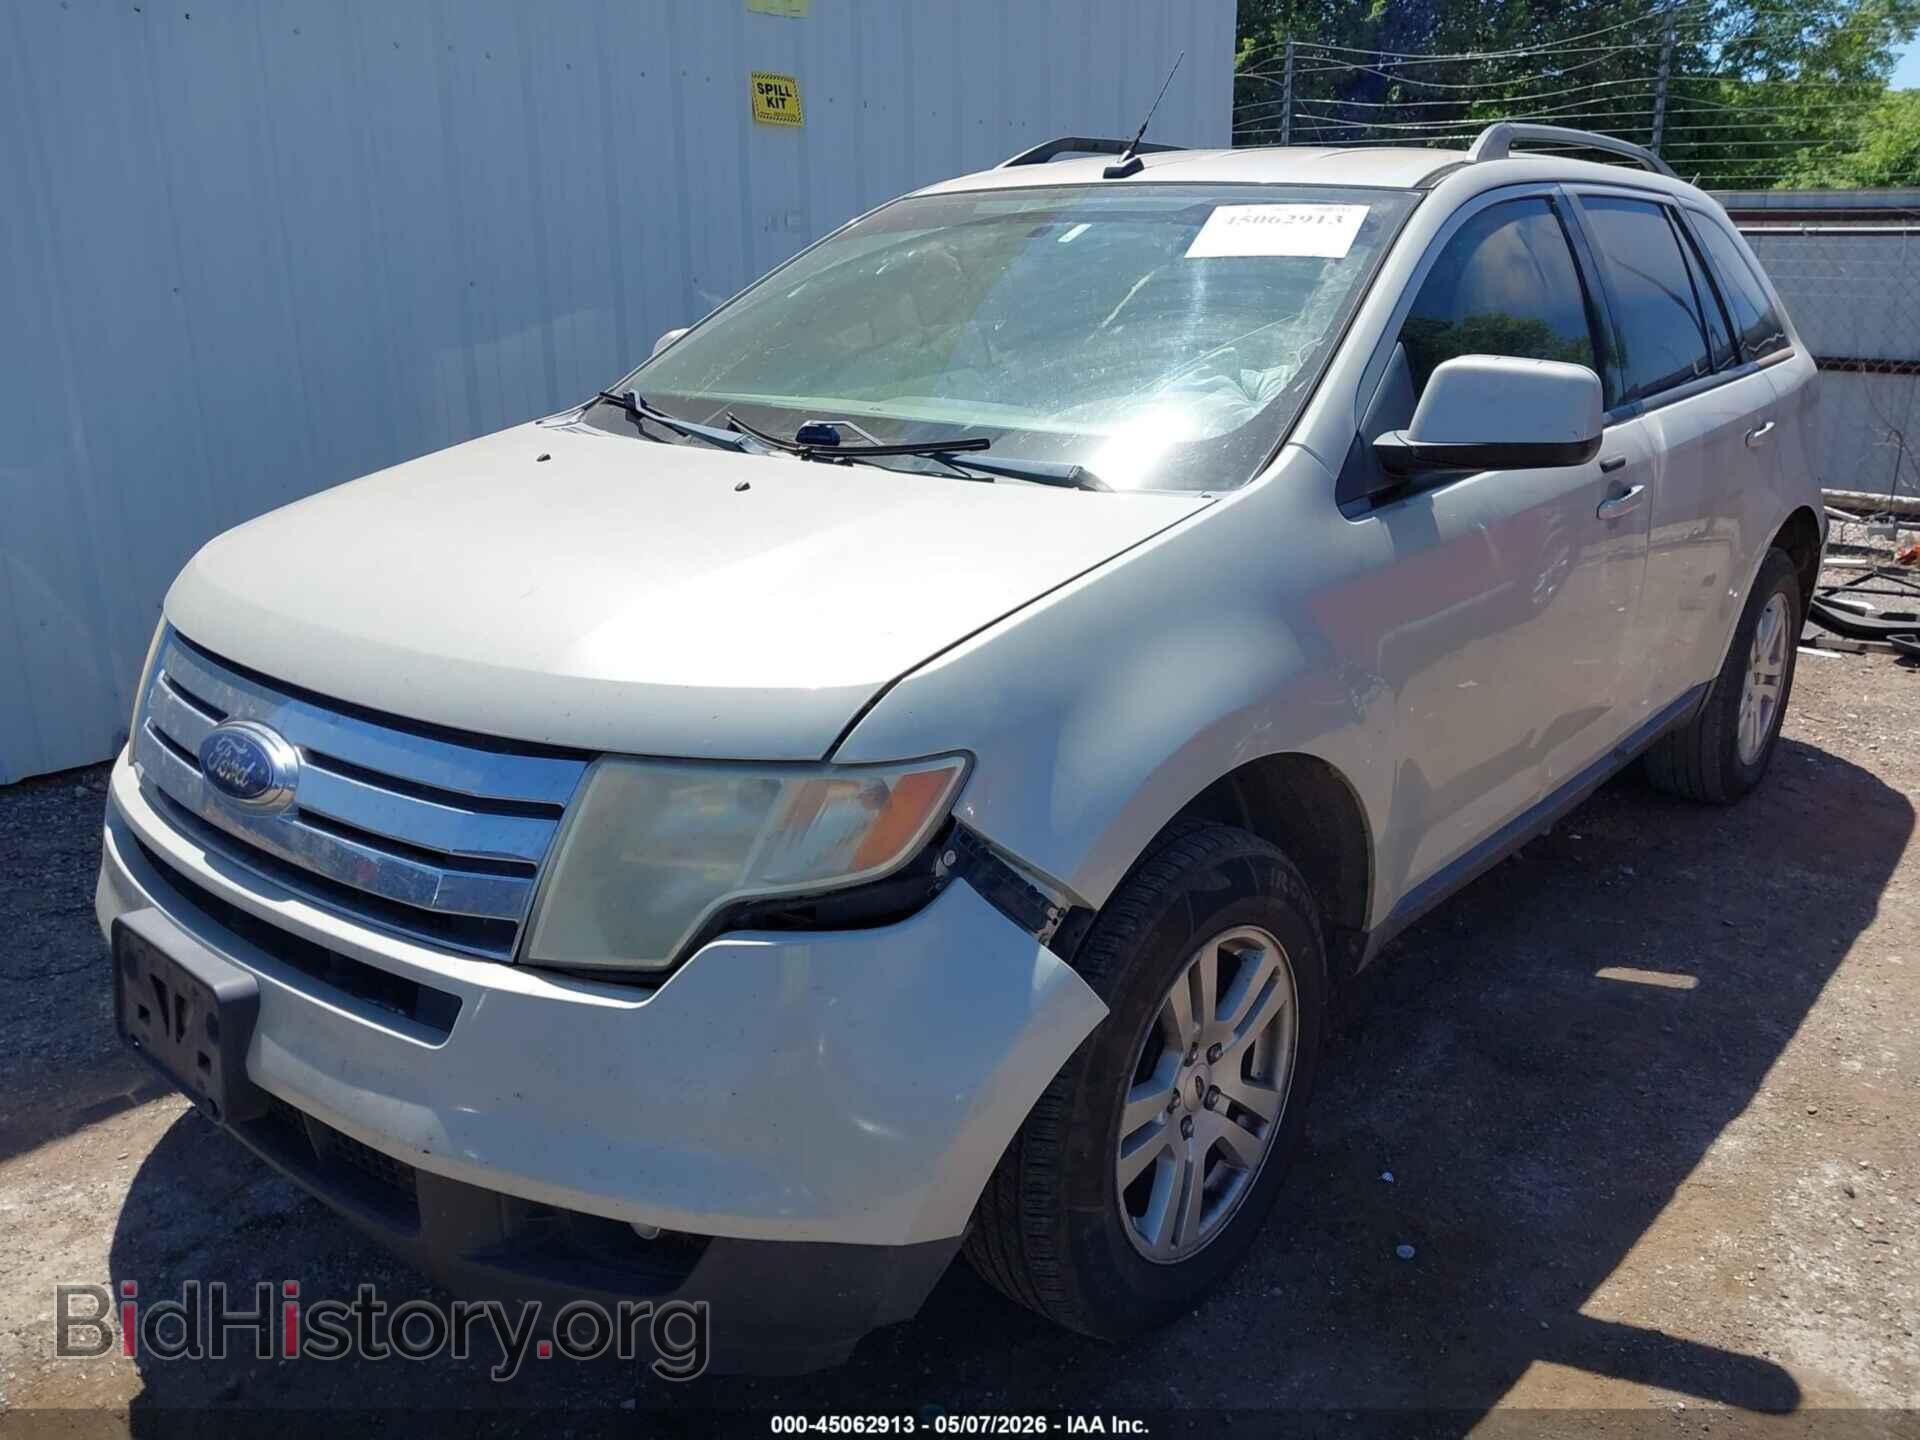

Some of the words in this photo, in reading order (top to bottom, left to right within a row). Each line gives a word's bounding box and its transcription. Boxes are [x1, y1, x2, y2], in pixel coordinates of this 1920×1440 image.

[757, 83, 792, 97] SPILL
[766, 96, 786, 109] KIT
[206, 737, 257, 788] Ford
